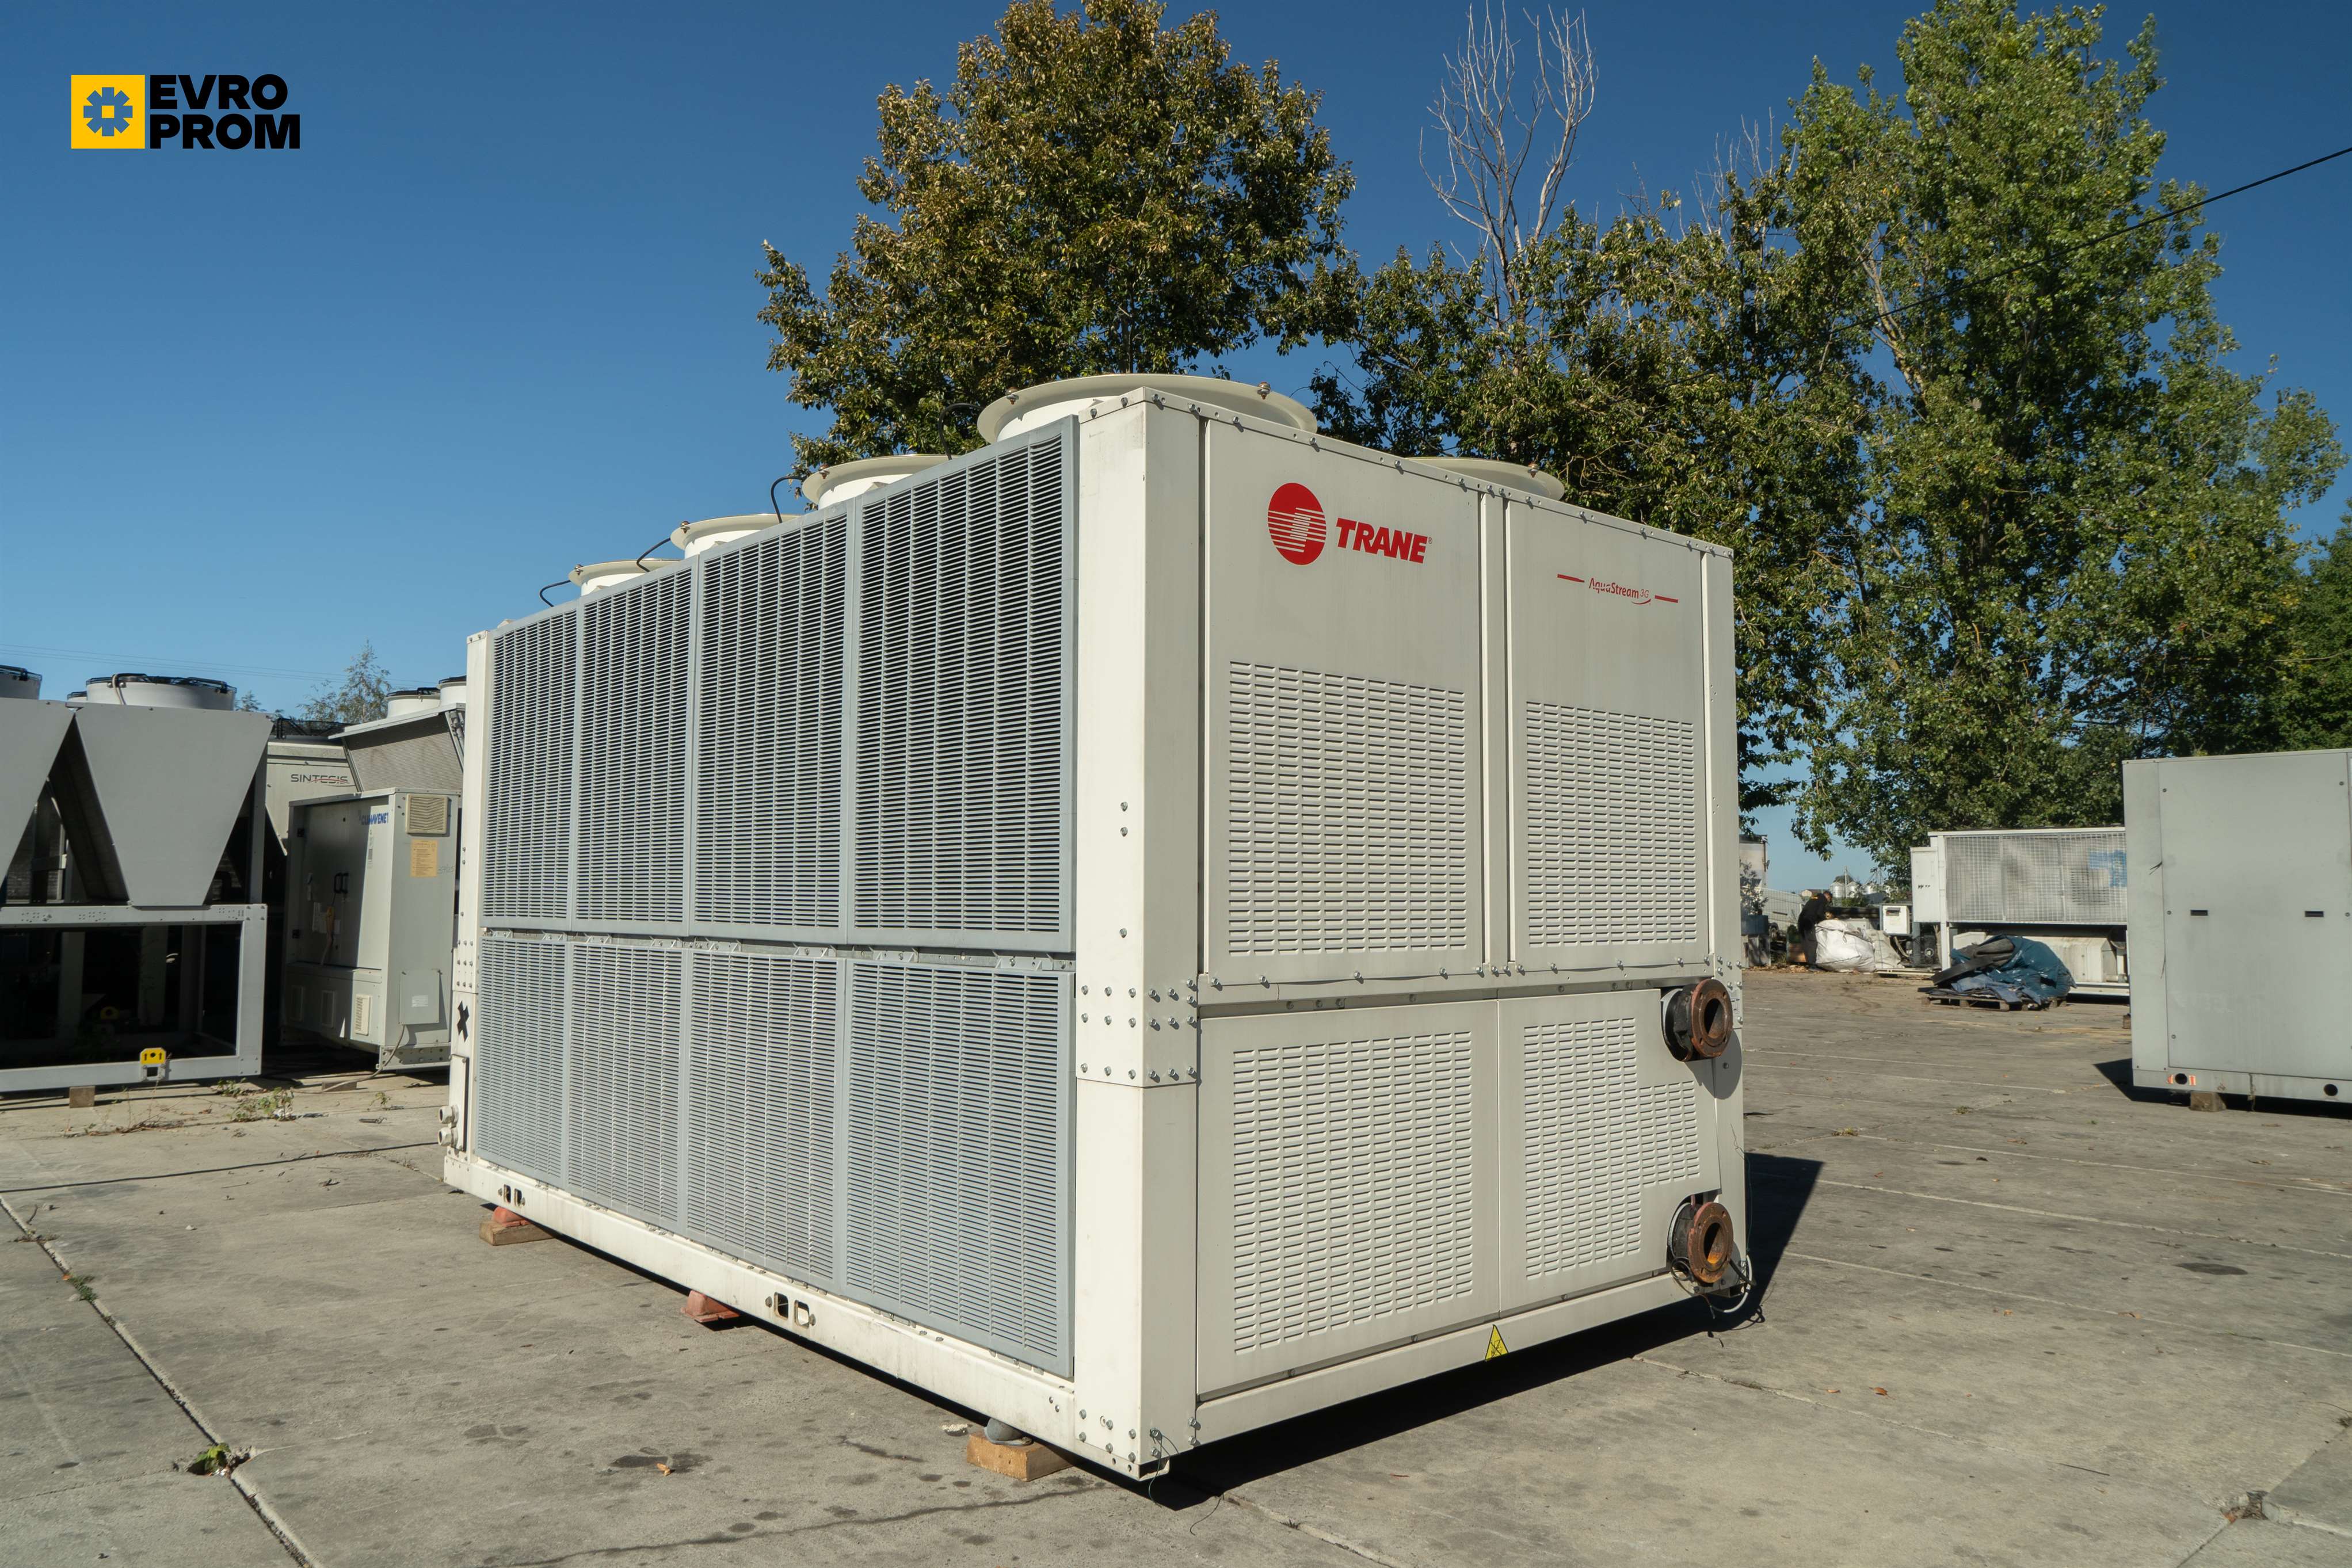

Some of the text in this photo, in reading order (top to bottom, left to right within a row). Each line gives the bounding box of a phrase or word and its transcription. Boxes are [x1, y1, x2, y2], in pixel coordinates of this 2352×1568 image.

[1589, 578, 1649, 599] AquaStream 3G
[291, 774, 349, 784] SINTESIS
